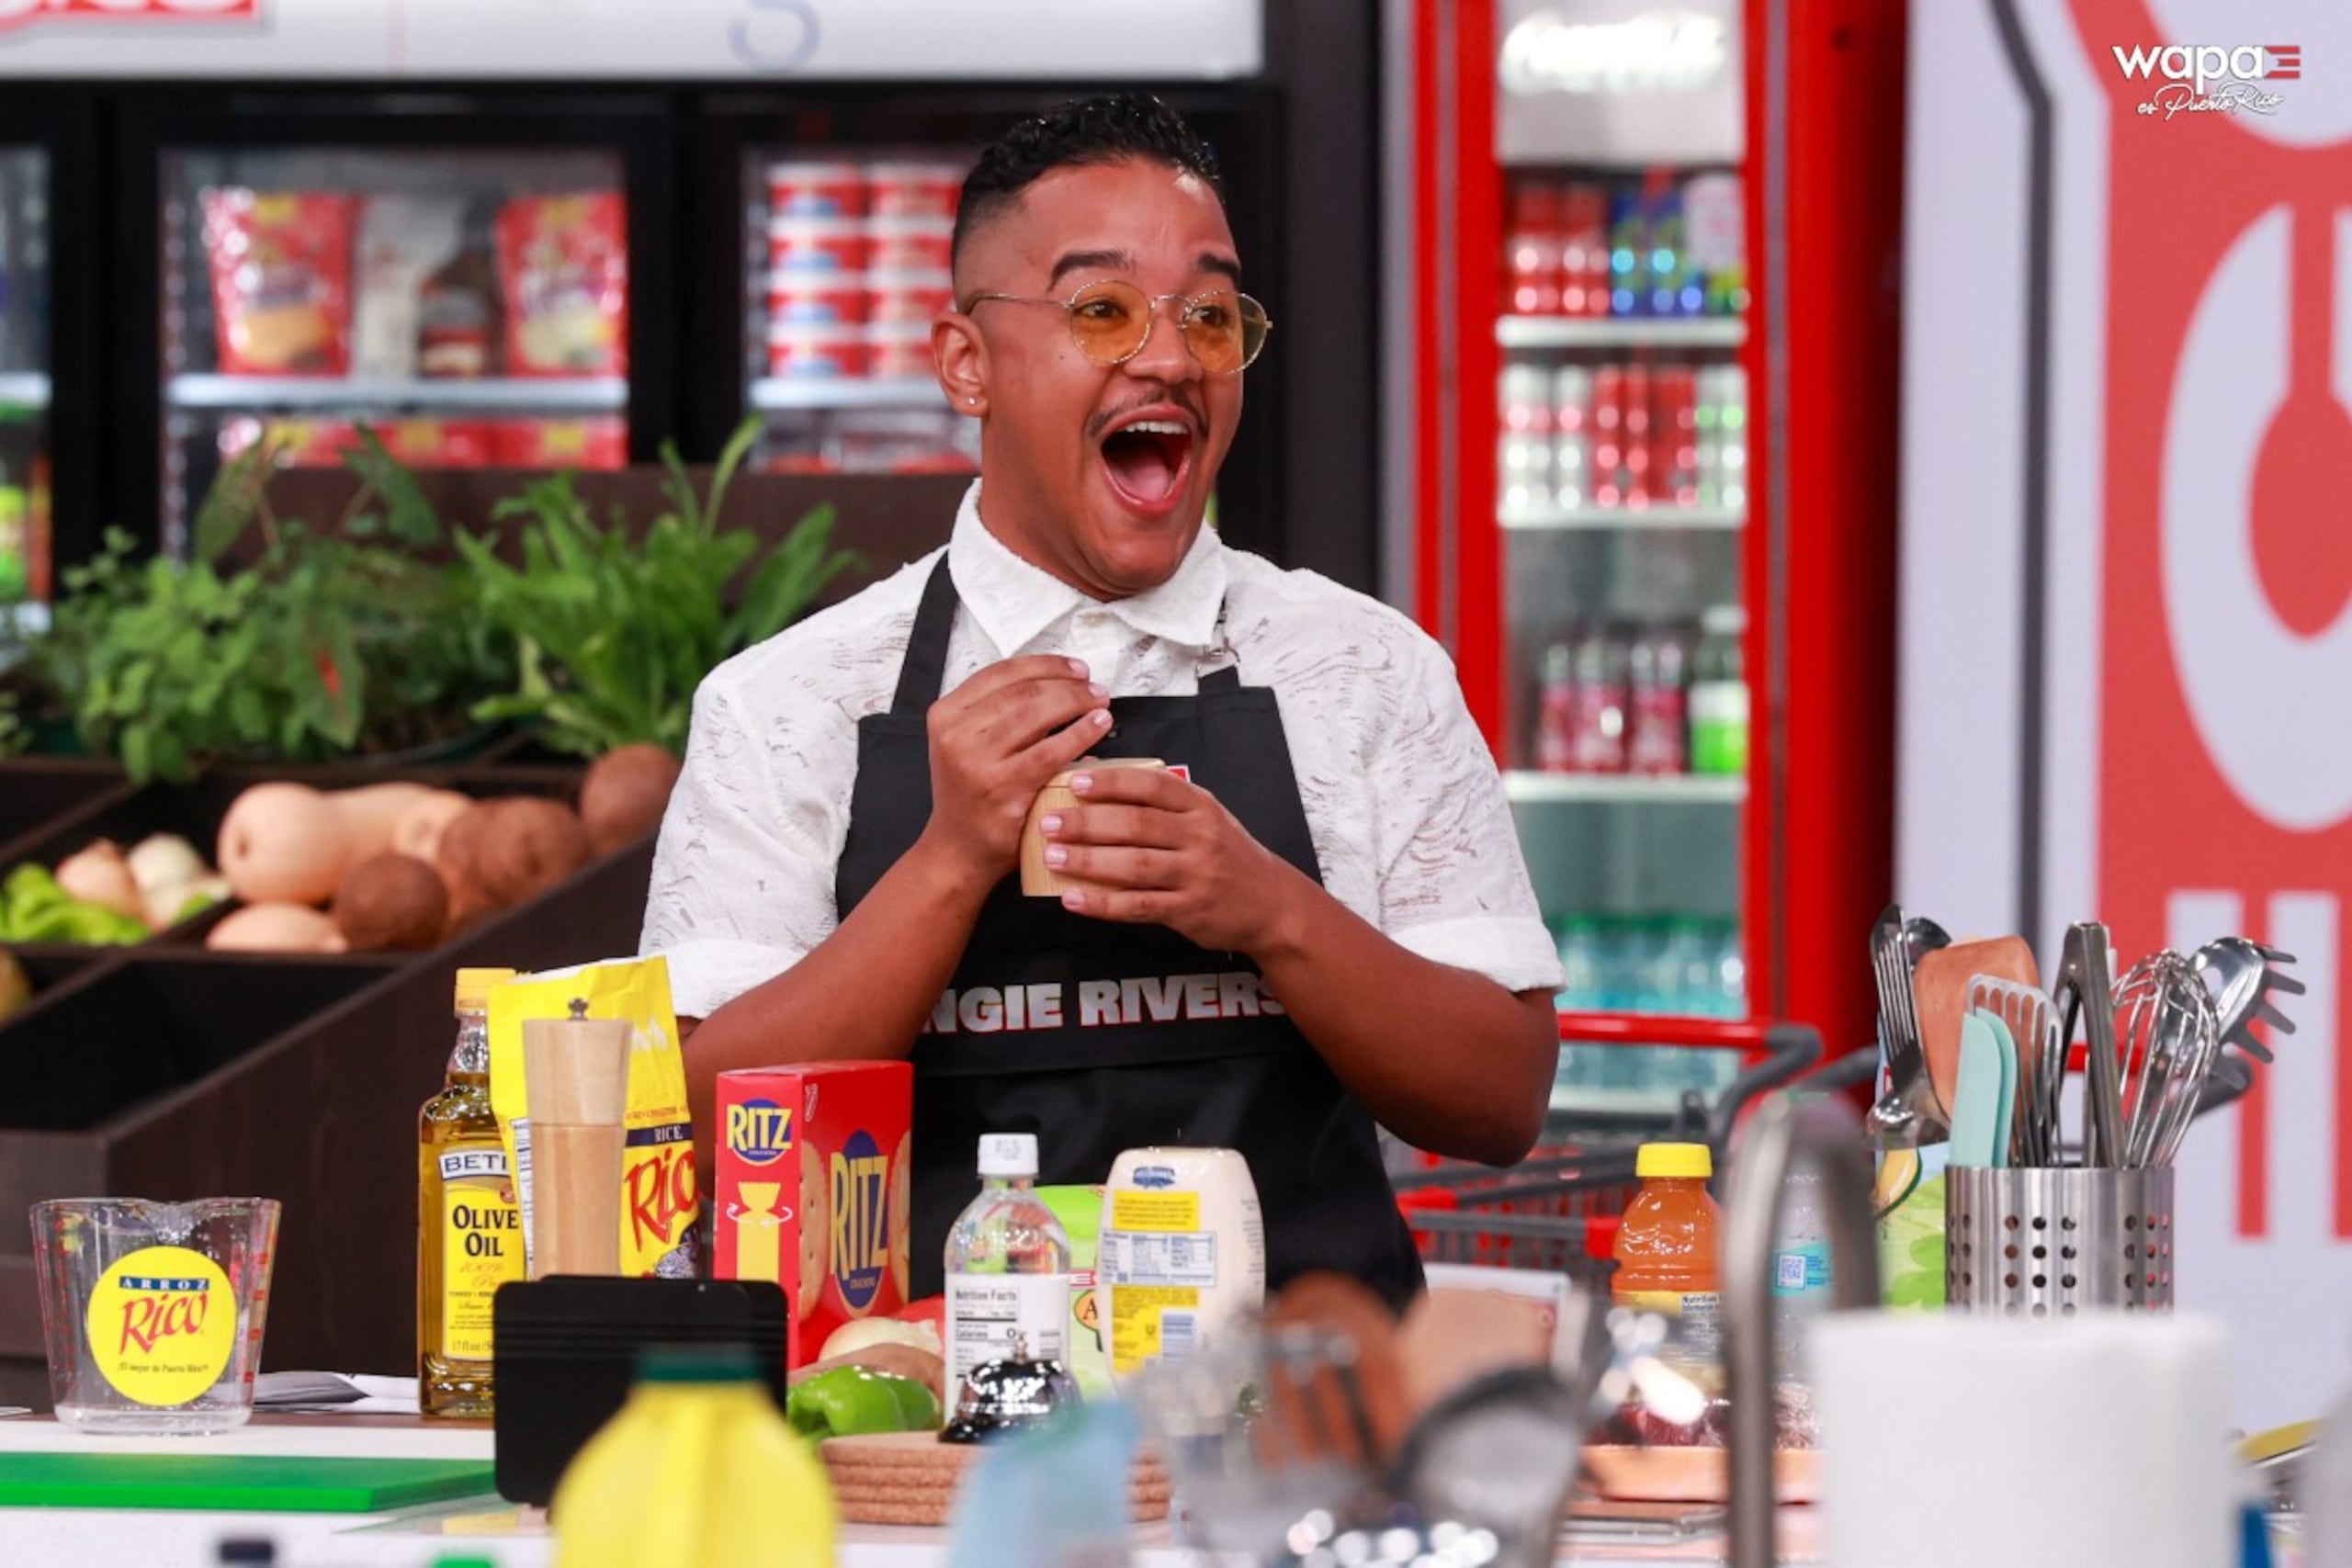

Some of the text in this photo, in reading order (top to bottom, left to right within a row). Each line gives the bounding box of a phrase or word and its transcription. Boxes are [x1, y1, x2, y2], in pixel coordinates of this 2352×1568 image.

[922, 983, 1064, 1033] NGIE
[654, 1124, 684, 1143] RICE
[727, 1104, 792, 1152] RITZ
[444, 1154, 507, 1172] BETI
[624, 1146, 698, 1252] Ric
[453, 1204, 519, 1229] OLIVE
[831, 1152, 888, 1280] RITZ
[465, 1232, 503, 1257] OIL
[122, 1277, 208, 1290] ARROZ
[991, 1289, 1016, 1301] Facts
[119, 1292, 208, 1357] Rico
